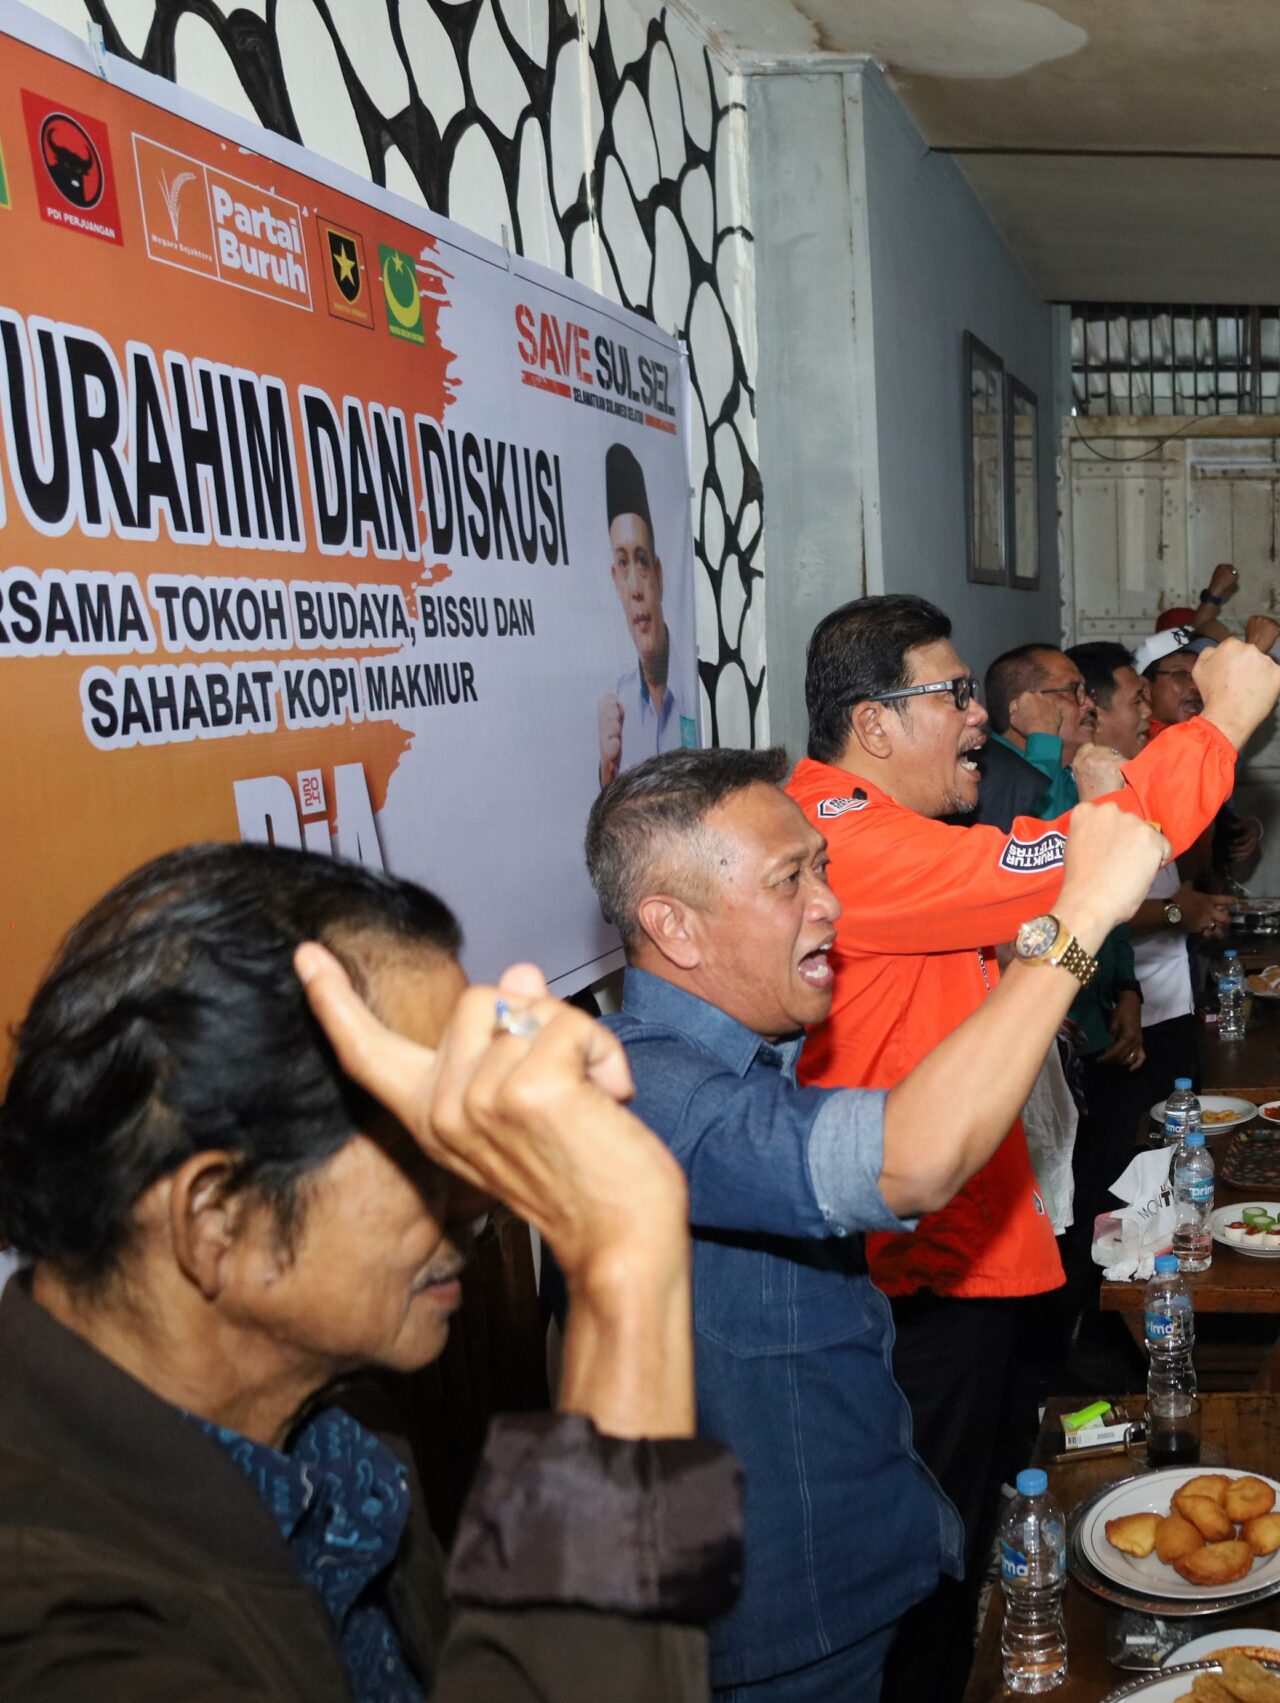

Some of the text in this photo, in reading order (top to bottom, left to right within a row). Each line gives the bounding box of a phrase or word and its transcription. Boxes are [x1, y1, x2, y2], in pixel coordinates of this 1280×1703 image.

[47, 207, 115, 238] PDI PERJUANGAN
[212, 184, 301, 254] Partai
[218, 227, 306, 293] Buruh
[304, 394, 416, 553] DAN
[419, 422, 569, 566] DISKUSI
[0, 580, 535, 647] SAMA TOKOH BUDAYA, BISSU DAN
[88, 662, 478, 738] SAHABAT KOPI MAKMUR
[1006, 846, 1064, 867] TRUKTUR
[1008, 838, 1065, 858] KTIFITAS
